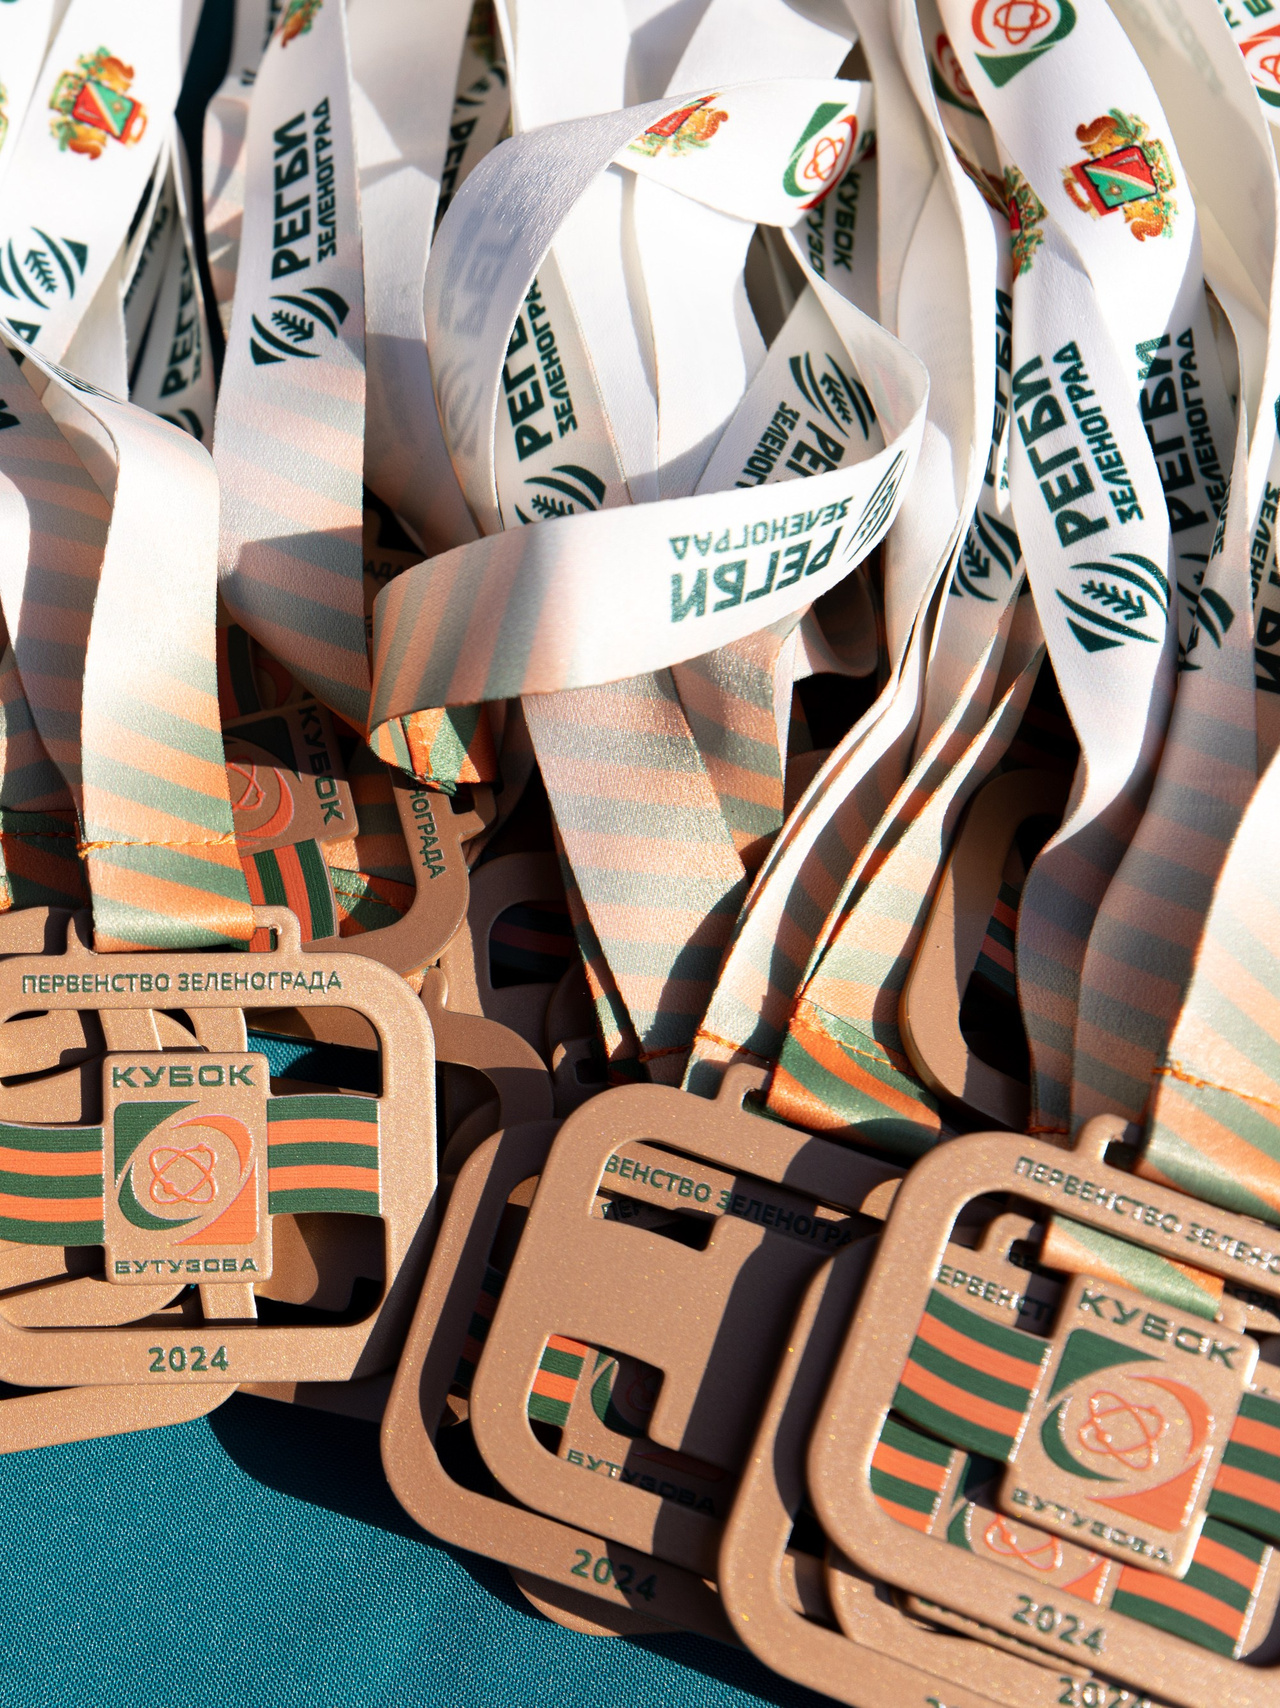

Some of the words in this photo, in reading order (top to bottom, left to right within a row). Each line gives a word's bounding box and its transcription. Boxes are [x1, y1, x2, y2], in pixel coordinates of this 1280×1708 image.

[271, 111, 311, 281] РЕГБИ
[312, 96, 337, 264] ЗЕЛЕНОГРАД
[1011, 354, 1110, 548] РЕГБИ
[1052, 340, 1145, 524] ЗЕЛЕНОГРАД
[1134, 333, 1209, 534] РЕГБИ
[668, 496, 854, 561] ЗЕЛЕНОГРАД
[670, 525, 844, 624] РЕГБИ
[298, 705, 346, 827] КУБОК
[22, 973, 170, 993] ПЕРВЕНСТВО
[178, 971, 342, 994] ЗЕЛЕНОГРАДА
[111, 1065, 257, 1089] КУБОК
[1014, 1155, 1183, 1234] ПЕРВЕНСТВО
[115, 1258, 260, 1275] БУТУЗОВА
[147, 1346, 230, 1374] 2024
[1077, 1286, 1243, 1370] КУБОК
[1013, 1488, 1173, 1564] БУТУЗОВА
[571, 1548, 658, 1602] 2024
[1012, 1594, 1108, 1656] 2024
